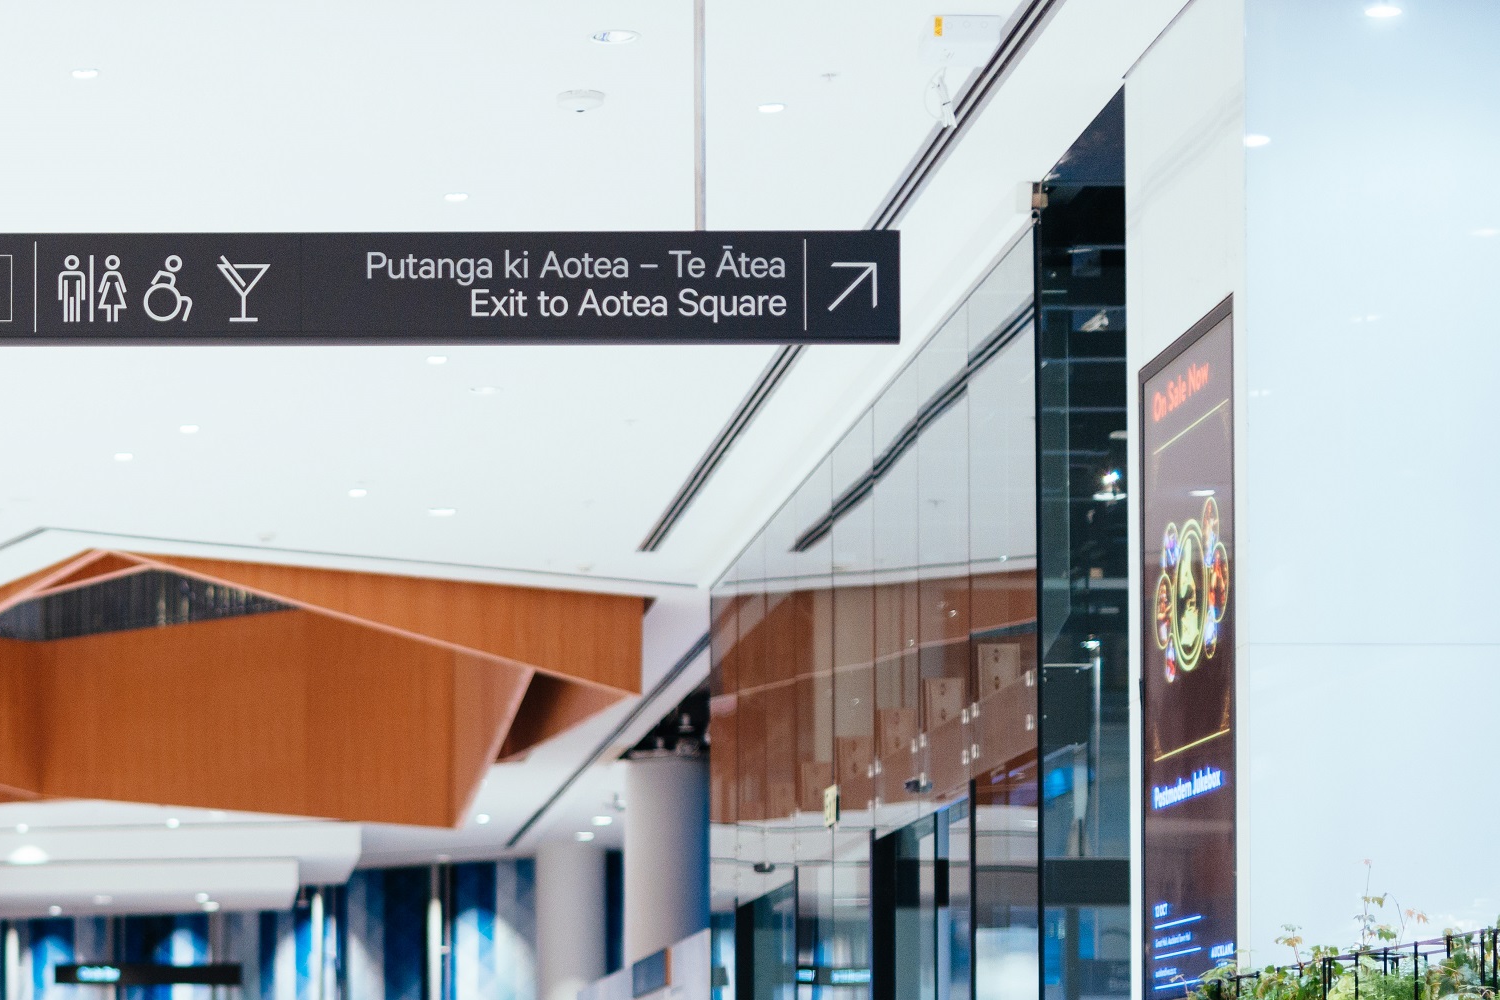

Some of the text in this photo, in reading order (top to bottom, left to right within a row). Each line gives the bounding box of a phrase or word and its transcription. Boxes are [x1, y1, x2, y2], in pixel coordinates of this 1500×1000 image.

[366, 251, 494, 286] Putanga
[504, 250, 529, 279] ki
[539, 251, 629, 279] Aotea
[668, 250, 706, 278] Te
[715, 246, 786, 279] Ātea
[470, 288, 787, 324] Exit to Aotea Square
[1153, 362, 1210, 422] On Sale Now
[1153, 767, 1221, 809] Postmodern Jukebox
